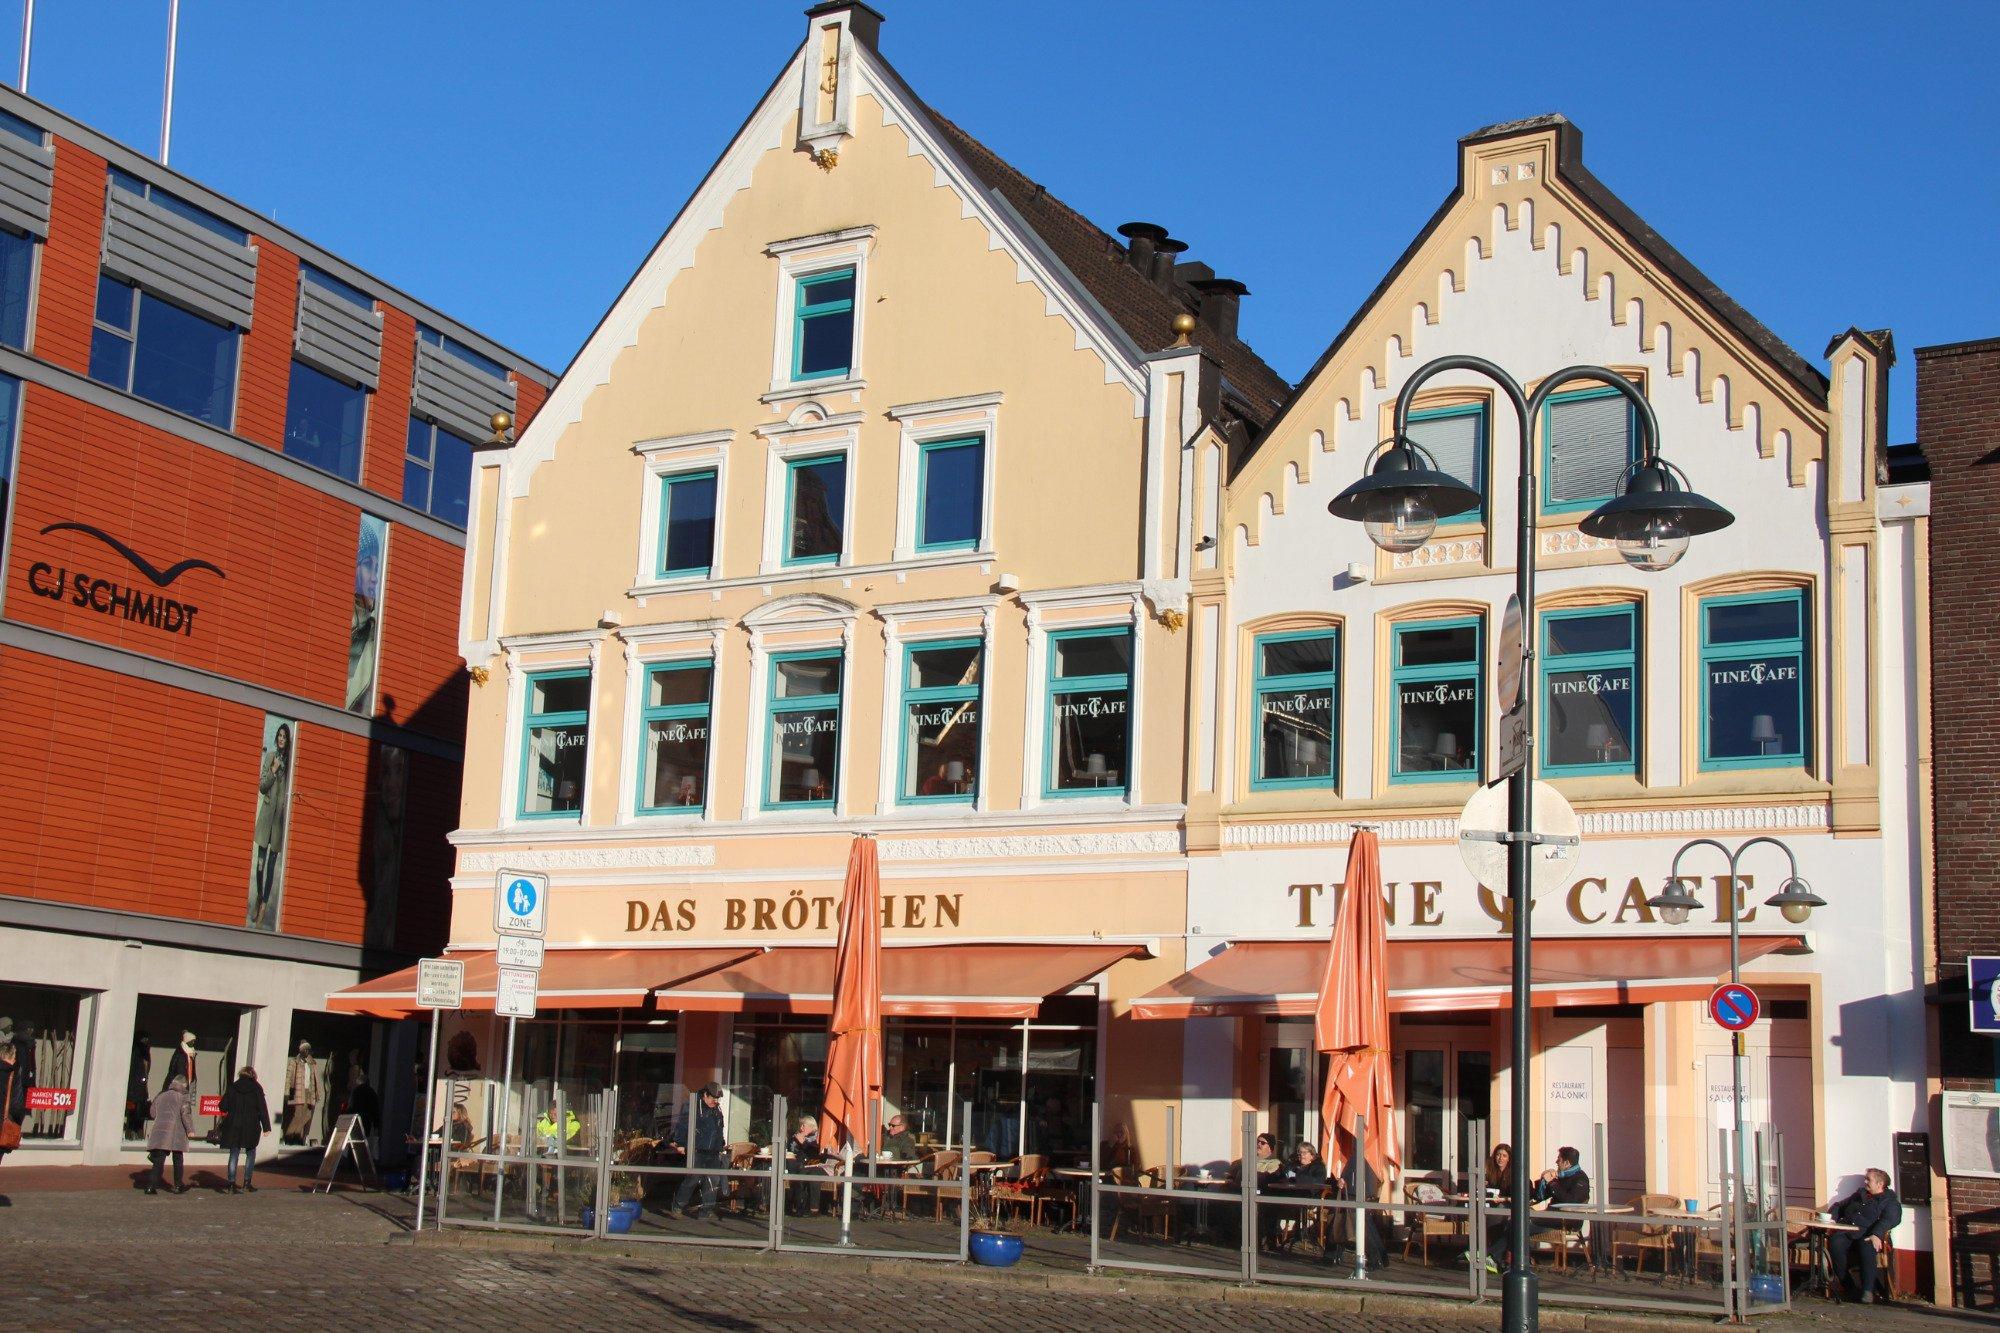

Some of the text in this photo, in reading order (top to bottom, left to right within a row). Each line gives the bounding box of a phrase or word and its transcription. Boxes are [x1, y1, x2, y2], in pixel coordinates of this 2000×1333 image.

[28, 562, 199, 637] CJ SCHMIDT
[1712, 670, 1750, 684] TINE
[1552, 681, 1587, 694] TINE
[1402, 691, 1435, 704] TINE
[624, 889, 964, 933] DAS BRÖTHEN
[508, 916, 532, 928] ZONE
[53, 1092, 72, 1106] 50%
